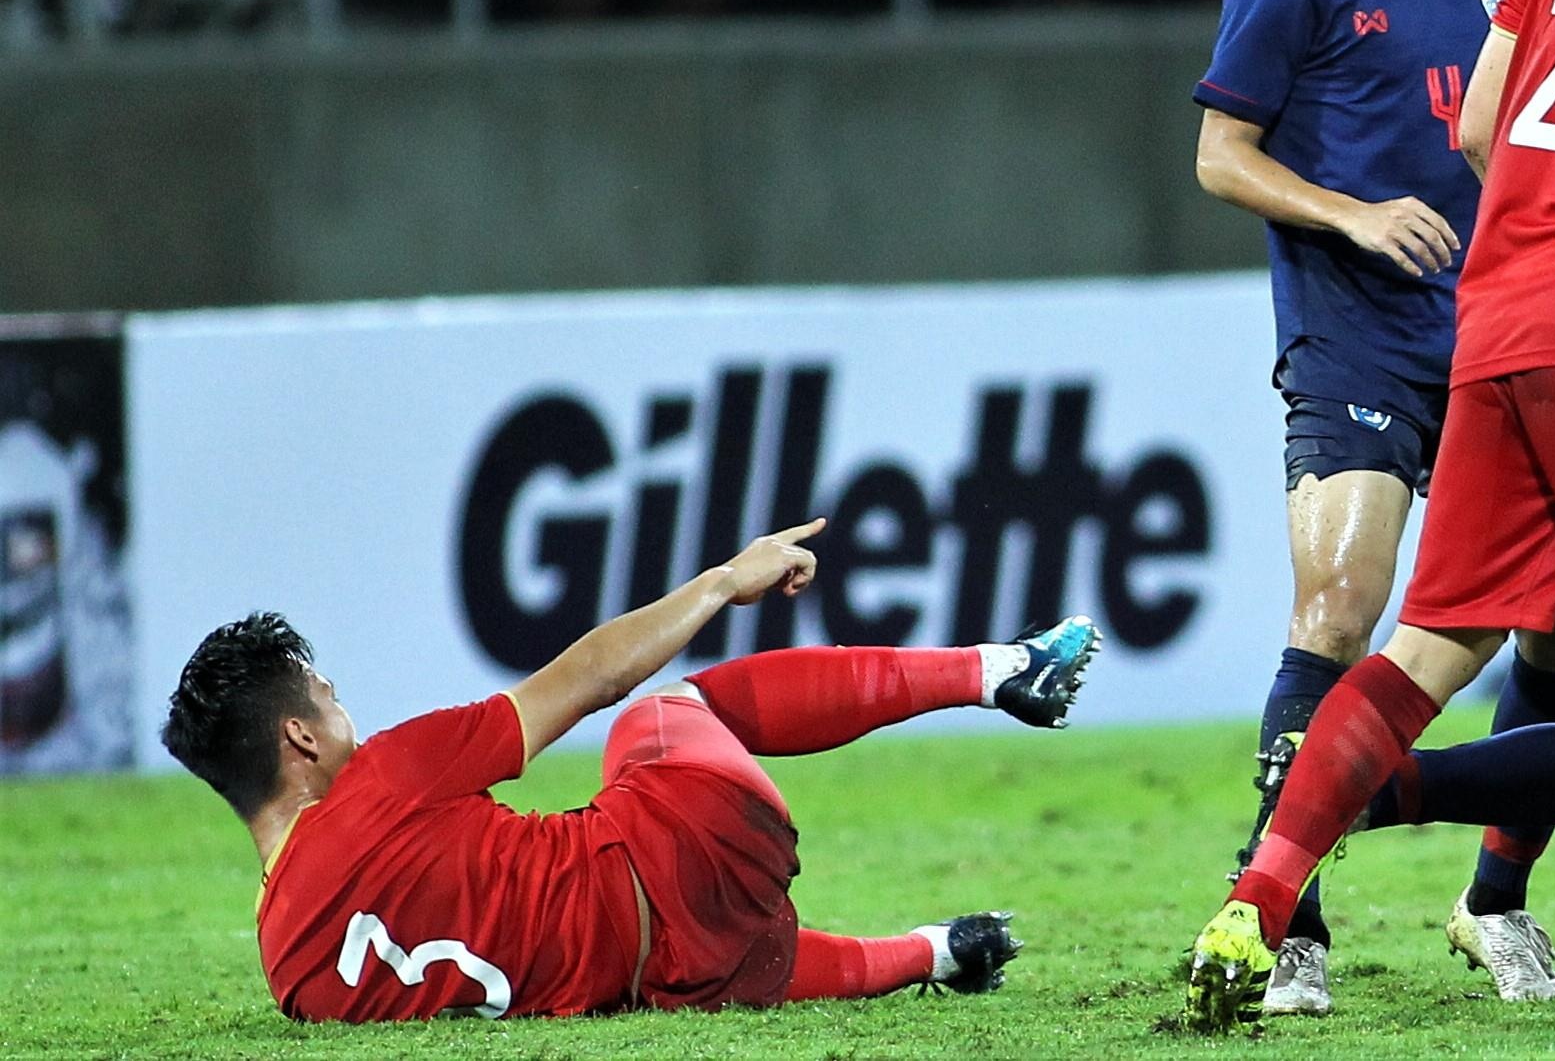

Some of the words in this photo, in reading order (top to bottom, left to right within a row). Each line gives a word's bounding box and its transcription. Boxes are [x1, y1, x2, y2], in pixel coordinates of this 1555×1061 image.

[1426, 64, 1462, 151] 4
[454, 361, 1213, 678] Gillette
[336, 910, 512, 1019] 3
